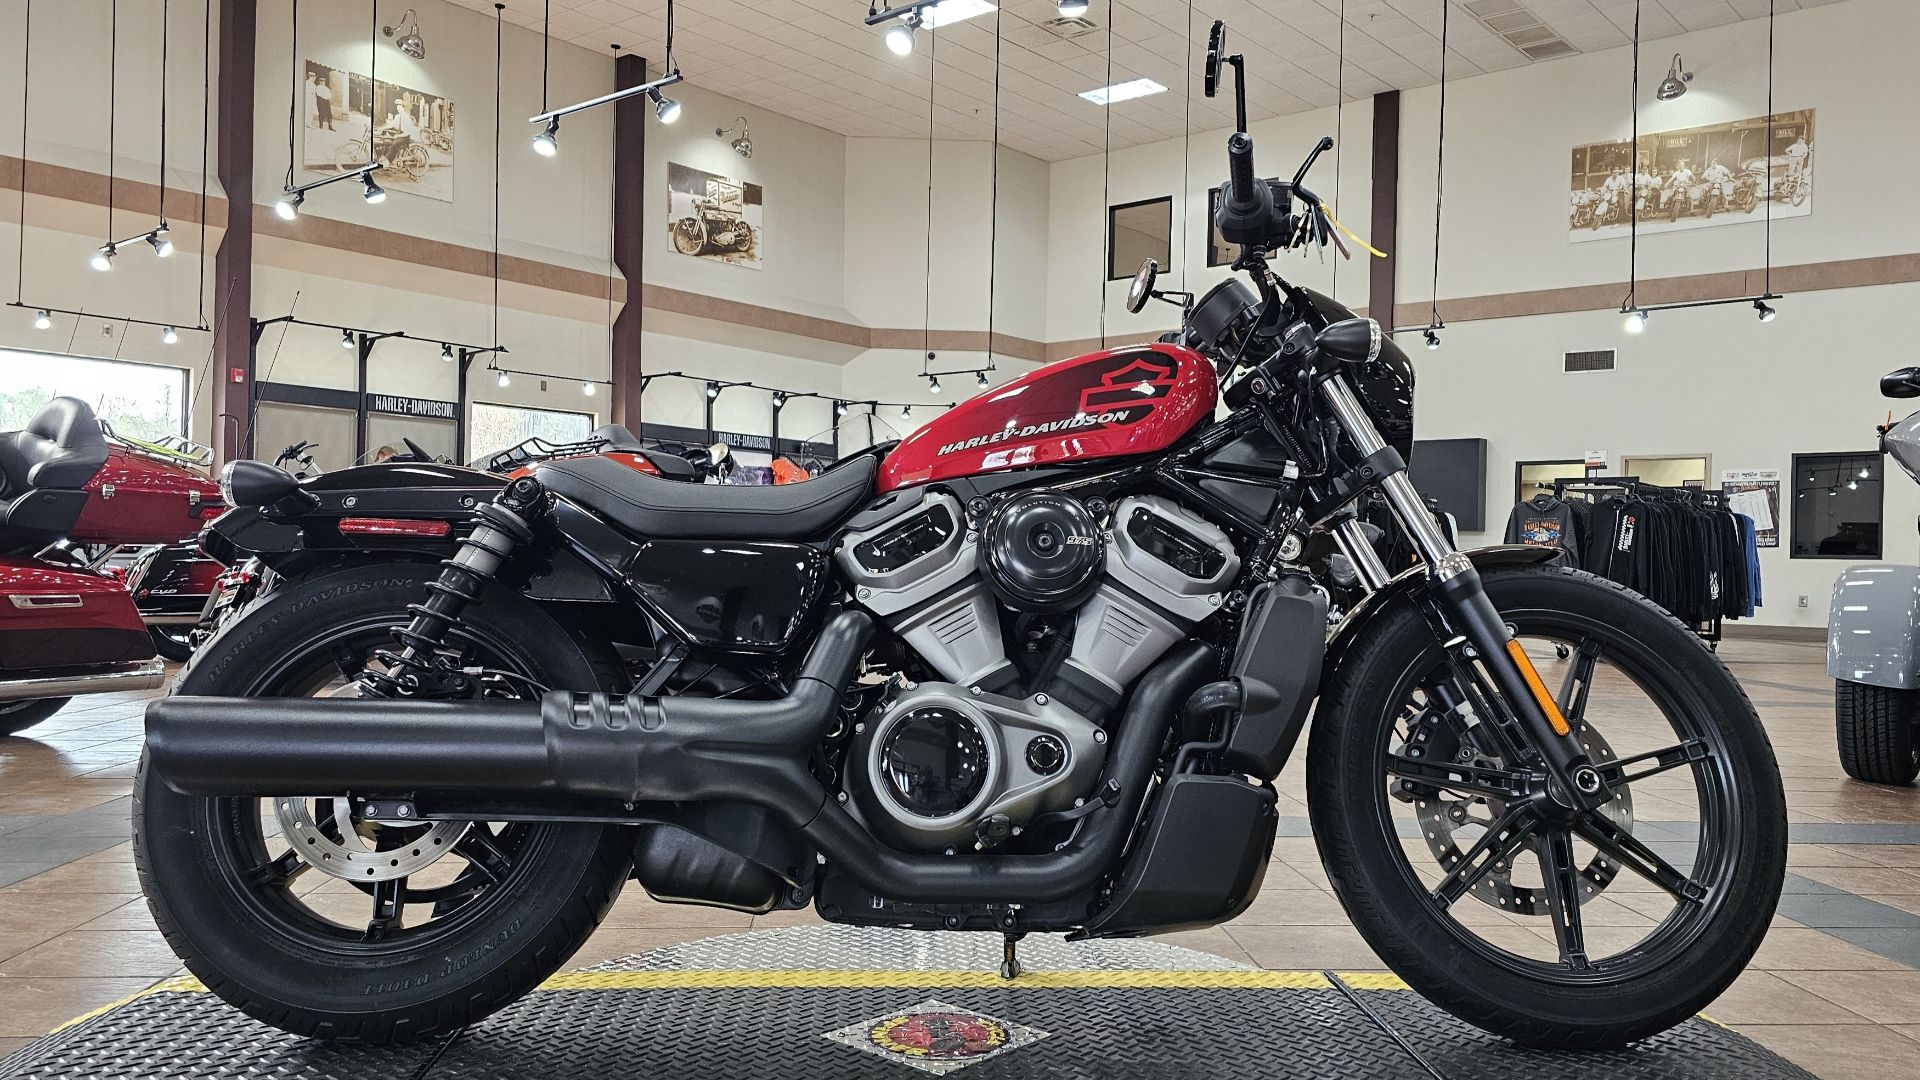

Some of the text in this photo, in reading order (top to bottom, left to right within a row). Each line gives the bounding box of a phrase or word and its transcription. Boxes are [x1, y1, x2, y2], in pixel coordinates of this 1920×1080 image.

[718, 433, 770, 449] HARLEY-DAVIDSON
[936, 410, 1130, 456] HARLEY-DAVIDSON
[1066, 536, 1093, 545] 975
[440, 919, 522, 978] DUNLOP
